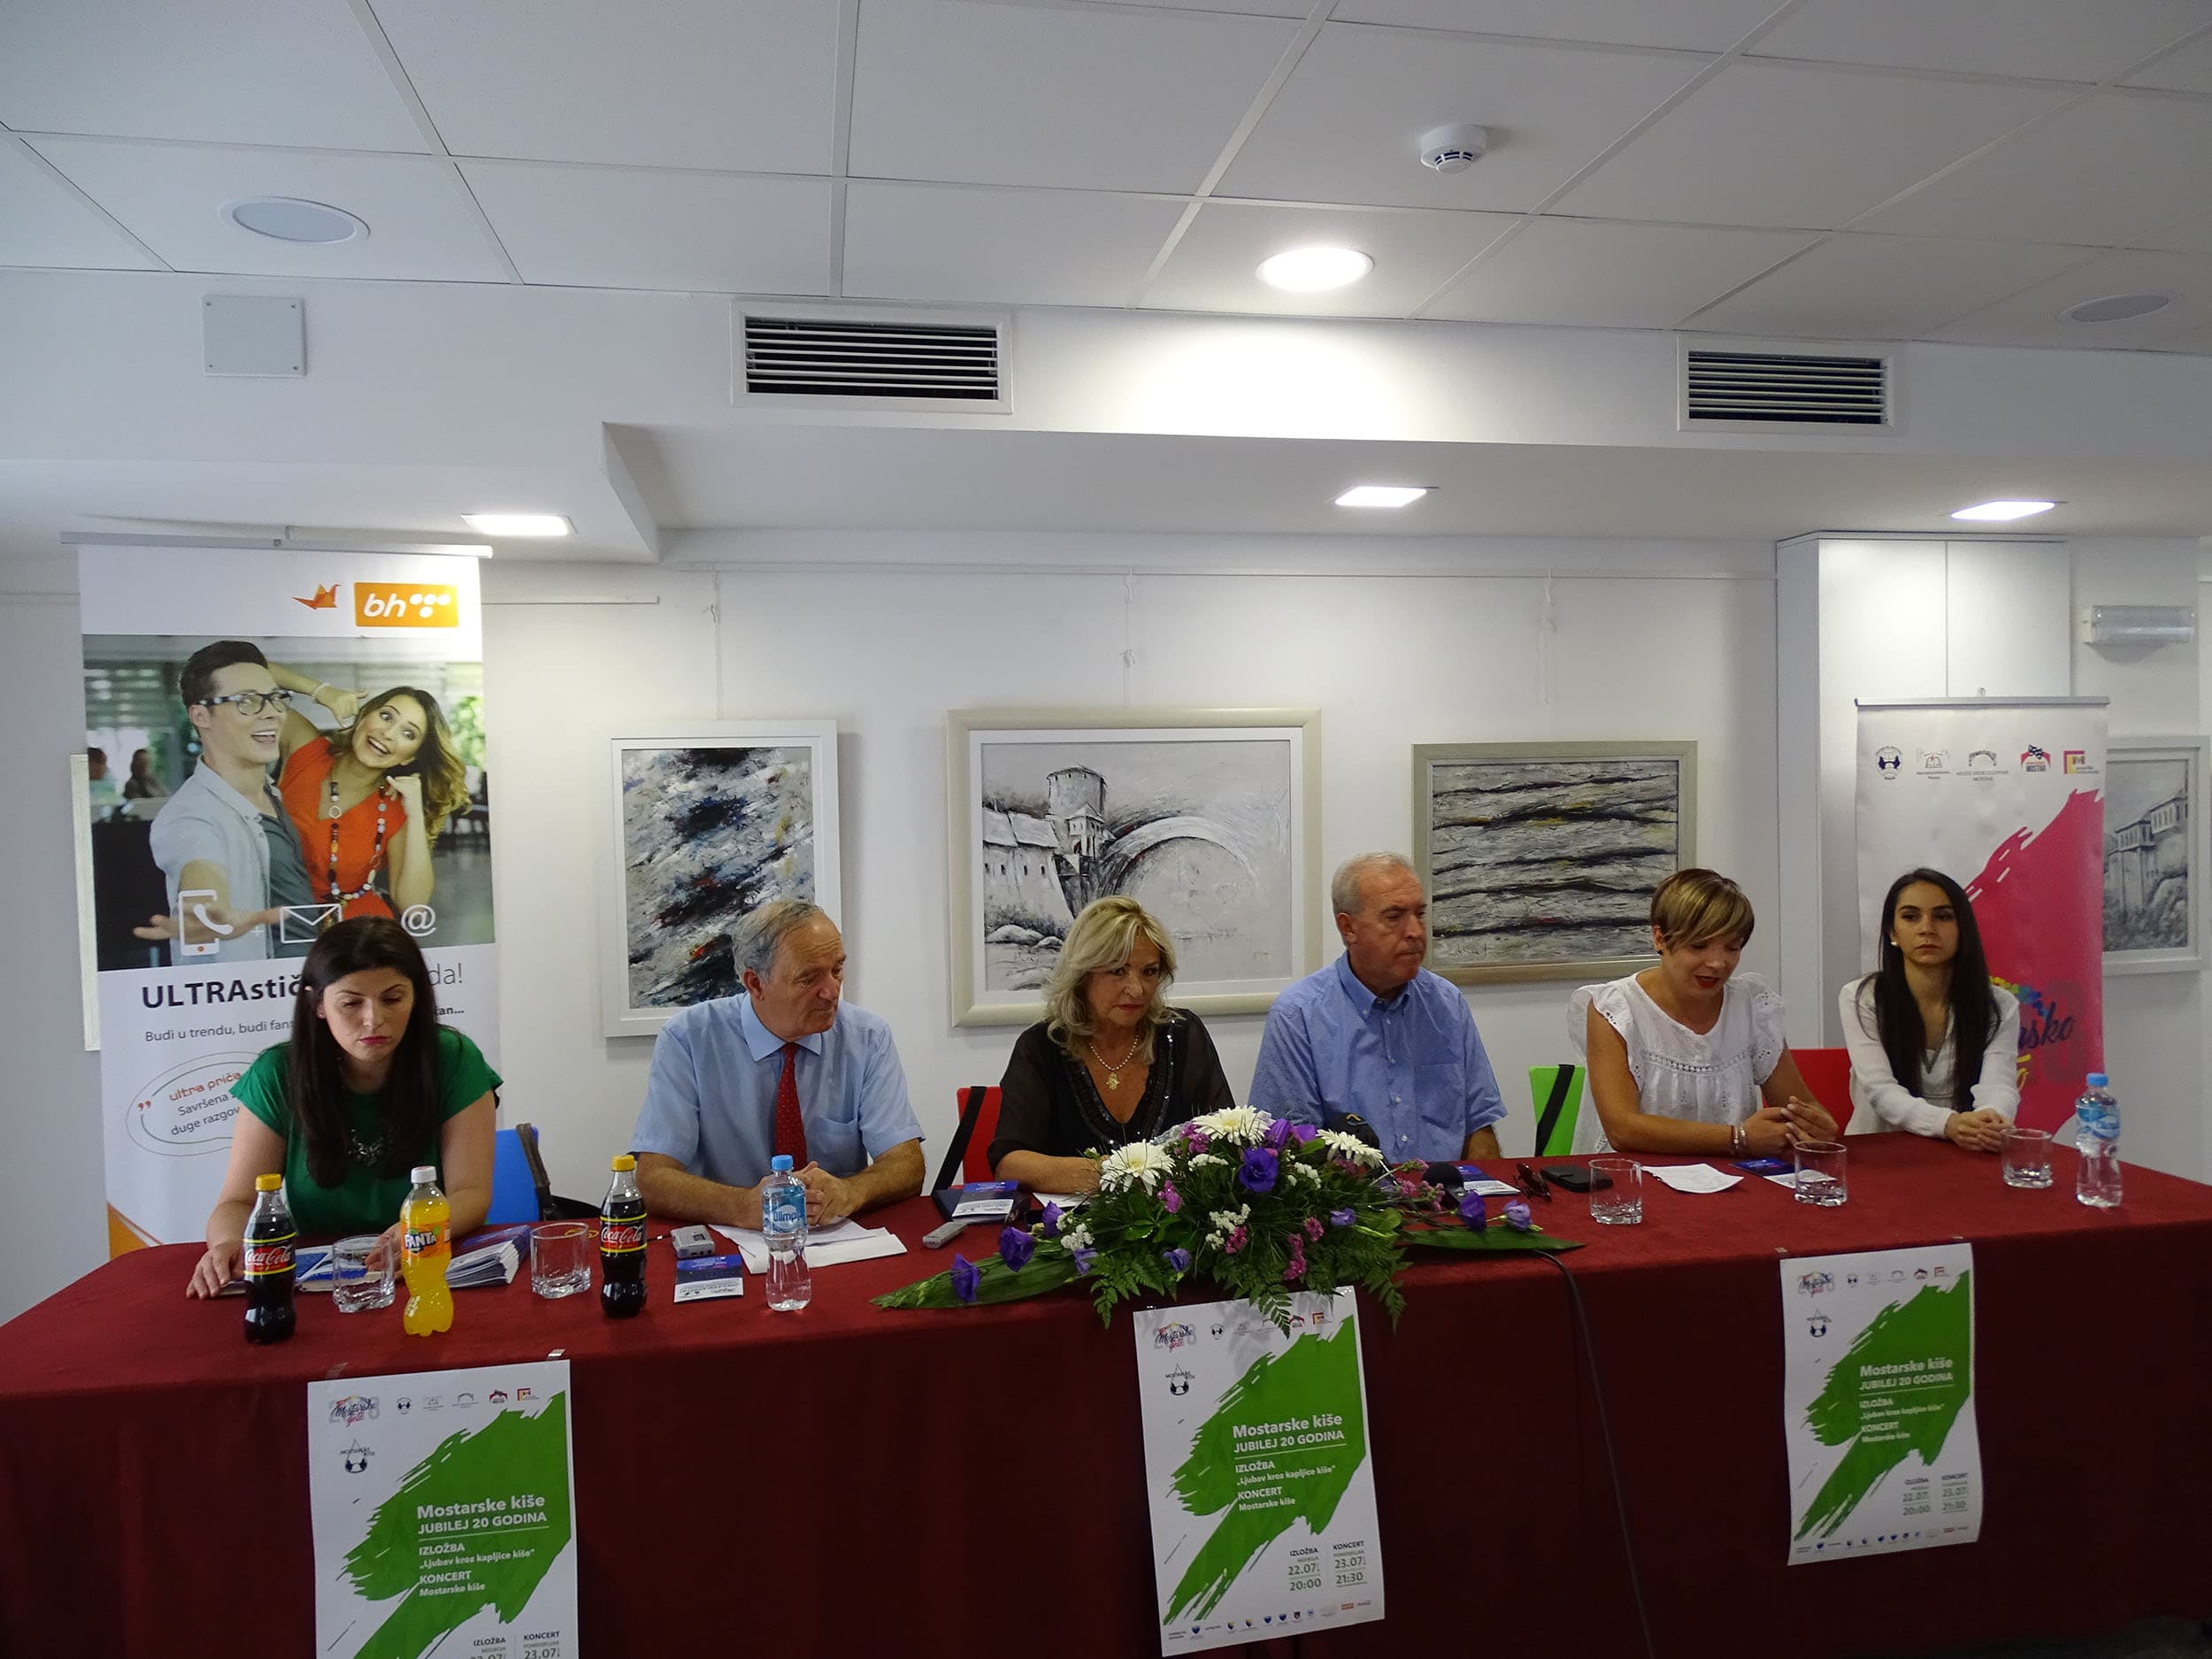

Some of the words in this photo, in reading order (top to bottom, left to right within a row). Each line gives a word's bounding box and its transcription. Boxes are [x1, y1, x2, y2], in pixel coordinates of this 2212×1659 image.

[145, 1030, 175, 1042] Budi
[178, 1031, 187, 1040] u
[189, 1025, 236, 1040] trendu,
[239, 1020, 267, 1034] budi
[169, 1084, 204, 1102] ultra
[207, 1071, 242, 1091] priča
[178, 1094, 229, 1116] Savršena
[171, 1120, 201, 1135] duge
[404, 1232, 437, 1249] FANTA
[1860, 1360, 1925, 1377] Mostarske
[1899, 1377, 1911, 1386] 20
[1913, 1372, 1954, 1385] GODINA
[1233, 1417, 1310, 1438] Mostarske
[1312, 1414, 1343, 1428] kiše
[1233, 1439, 1278, 1453] JUBILEJ
[1280, 1436, 1294, 1447] 20
[1297, 1430, 1345, 1444] GODINA
[1235, 1461, 1275, 1473] IZLOŽBA
[1238, 1486, 1283, 1500] KONCERT
[417, 1497, 507, 1519] Mostarske
[511, 1494, 546, 1509] kiše
[1239, 1501, 1279, 1511] Mostarske
[418, 1520, 469, 1534] JUBILEJ
[472, 1517, 488, 1529] 20
[492, 1511, 547, 1526] GODINA
[419, 1542, 465, 1555] IZLOŽBA
[1333, 1540, 1364, 1550] KONCERT
[456, 1555, 475, 1565] kroz
[476, 1552, 511, 1563] kapljice
[419, 1571, 472, 1585] KONCERT
[1289, 1578, 1322, 1592] 20:00
[1336, 1571, 1363, 1585] 21:30
[419, 1585, 466, 1596] Mostarske
[467, 1582, 486, 1592] kiše
[473, 1637, 506, 1646] IZLOŽBA
[523, 1631, 560, 1640] KONCERT
